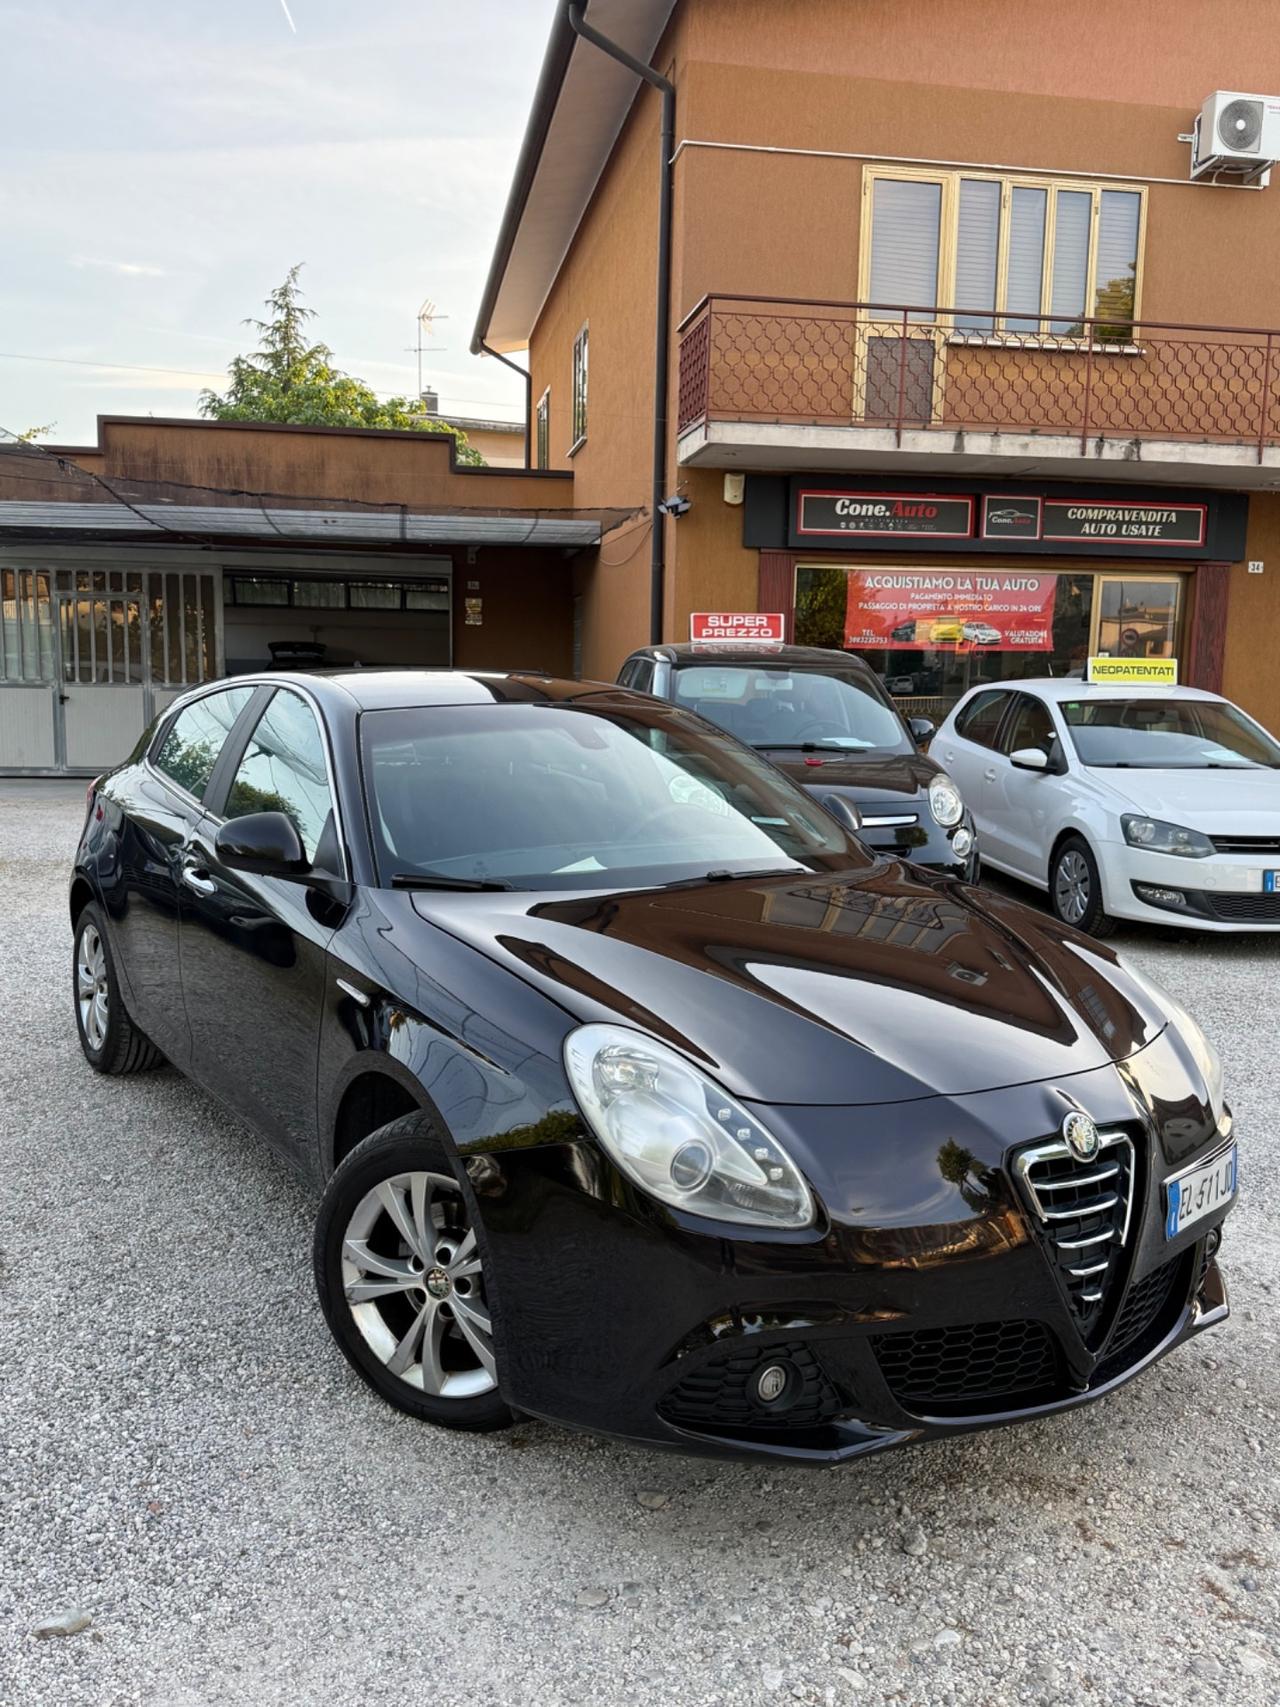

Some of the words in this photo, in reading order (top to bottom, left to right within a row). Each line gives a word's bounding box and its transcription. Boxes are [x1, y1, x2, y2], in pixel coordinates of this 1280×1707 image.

[835, 498, 938, 518] Cone.Auto
[1067, 507, 1177, 523] COMPRAVENDITA
[1081, 522, 1117, 535] AUTO
[1121, 523, 1163, 536] USATE
[865, 575, 954, 590] ACQUISTIAMO
[957, 577, 972, 590] LA
[975, 577, 1000, 591] TUA
[1002, 578, 1039, 592] AUTO
[910, 592, 953, 601] PAGAMENTO
[954, 593, 993, 602] IMMEDIATO
[858, 601, 898, 610] PASSAGGIO
[899, 602, 907, 610] DI
[954, 603, 983, 612] NOSTRO
[984, 604, 1010, 612] CARICO
[1011, 604, 1018, 612] IN
[707, 615, 768, 627] SUPER
[702, 628, 773, 637] PREZZO
[1092, 665, 1174, 676] NEOPATENTATI
